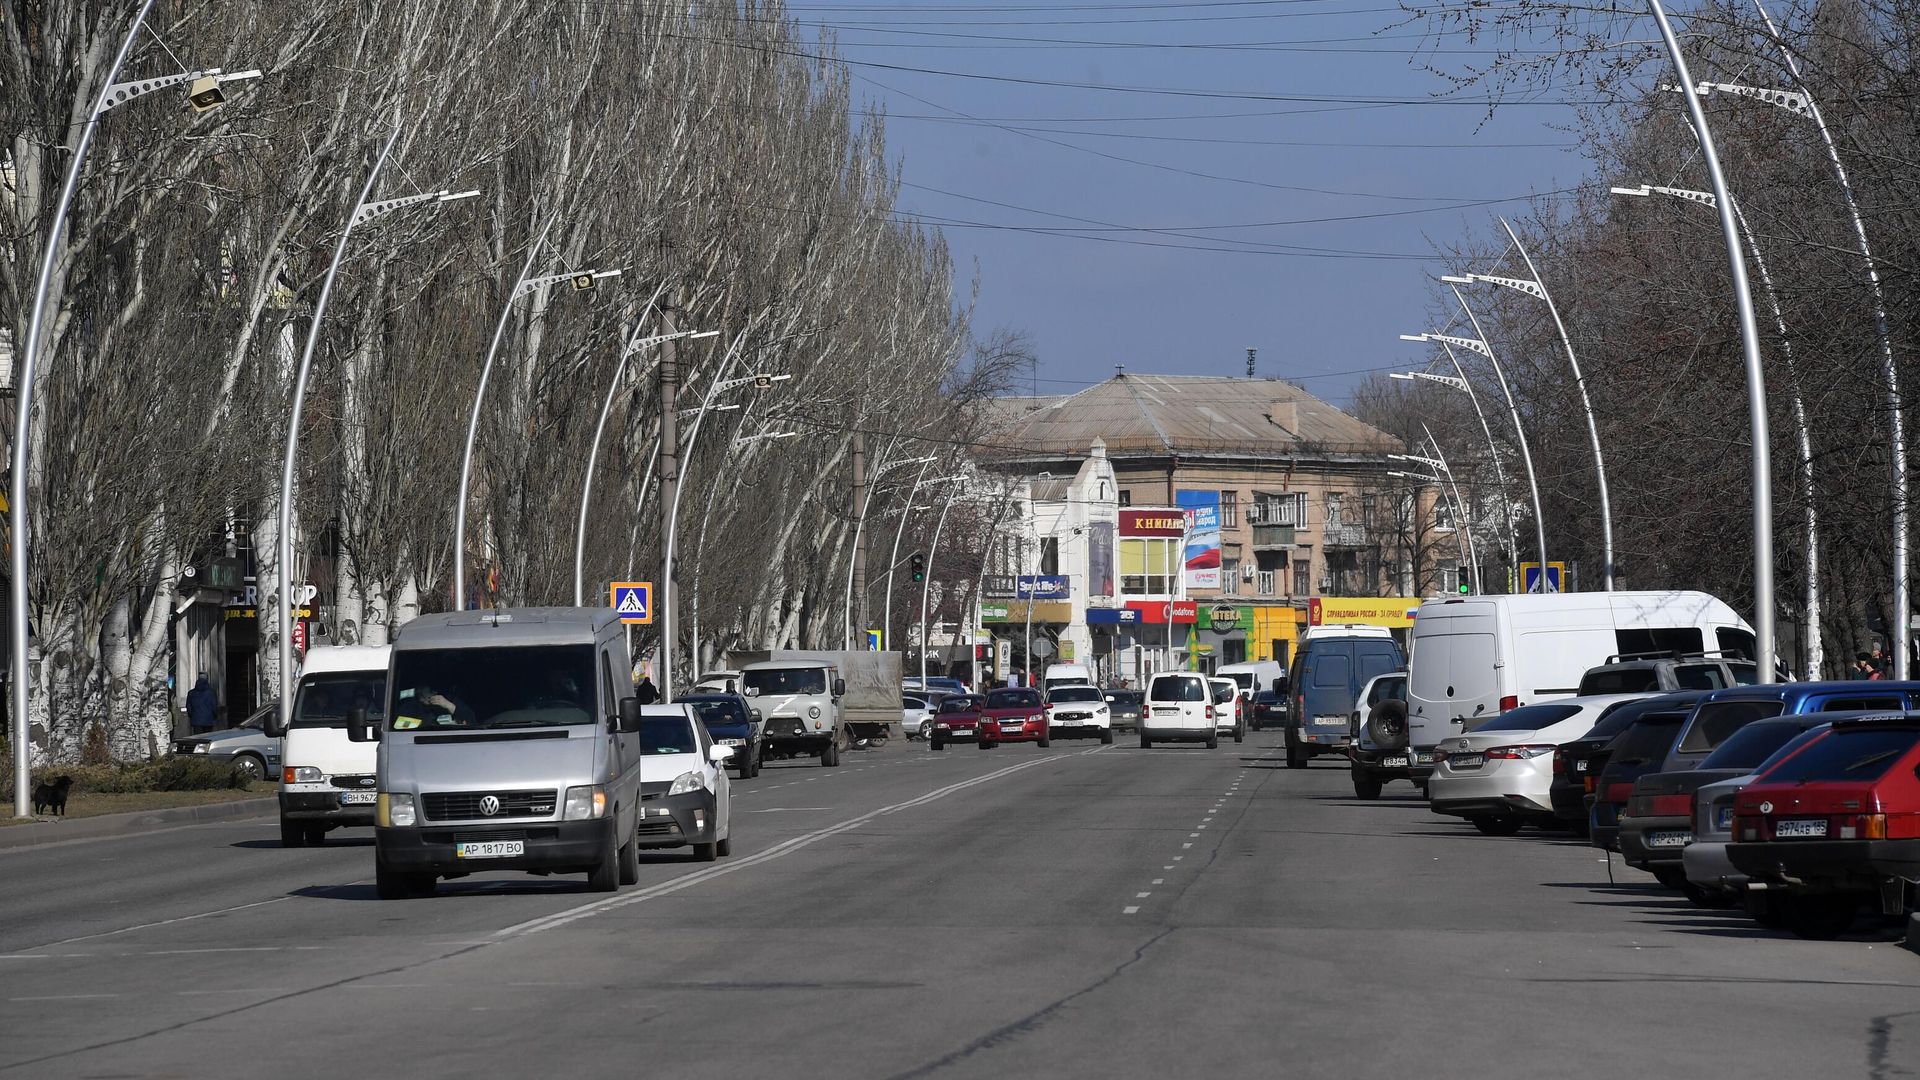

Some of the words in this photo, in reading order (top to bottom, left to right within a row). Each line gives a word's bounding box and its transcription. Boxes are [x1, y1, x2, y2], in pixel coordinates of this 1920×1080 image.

[1172, 607, 1195, 617] vodafone
[1360, 610, 1377, 618] РОССИЯ
[464, 844, 478, 855] AP
[482, 843, 503, 855] 1817
[506, 842, 522, 853] BO
